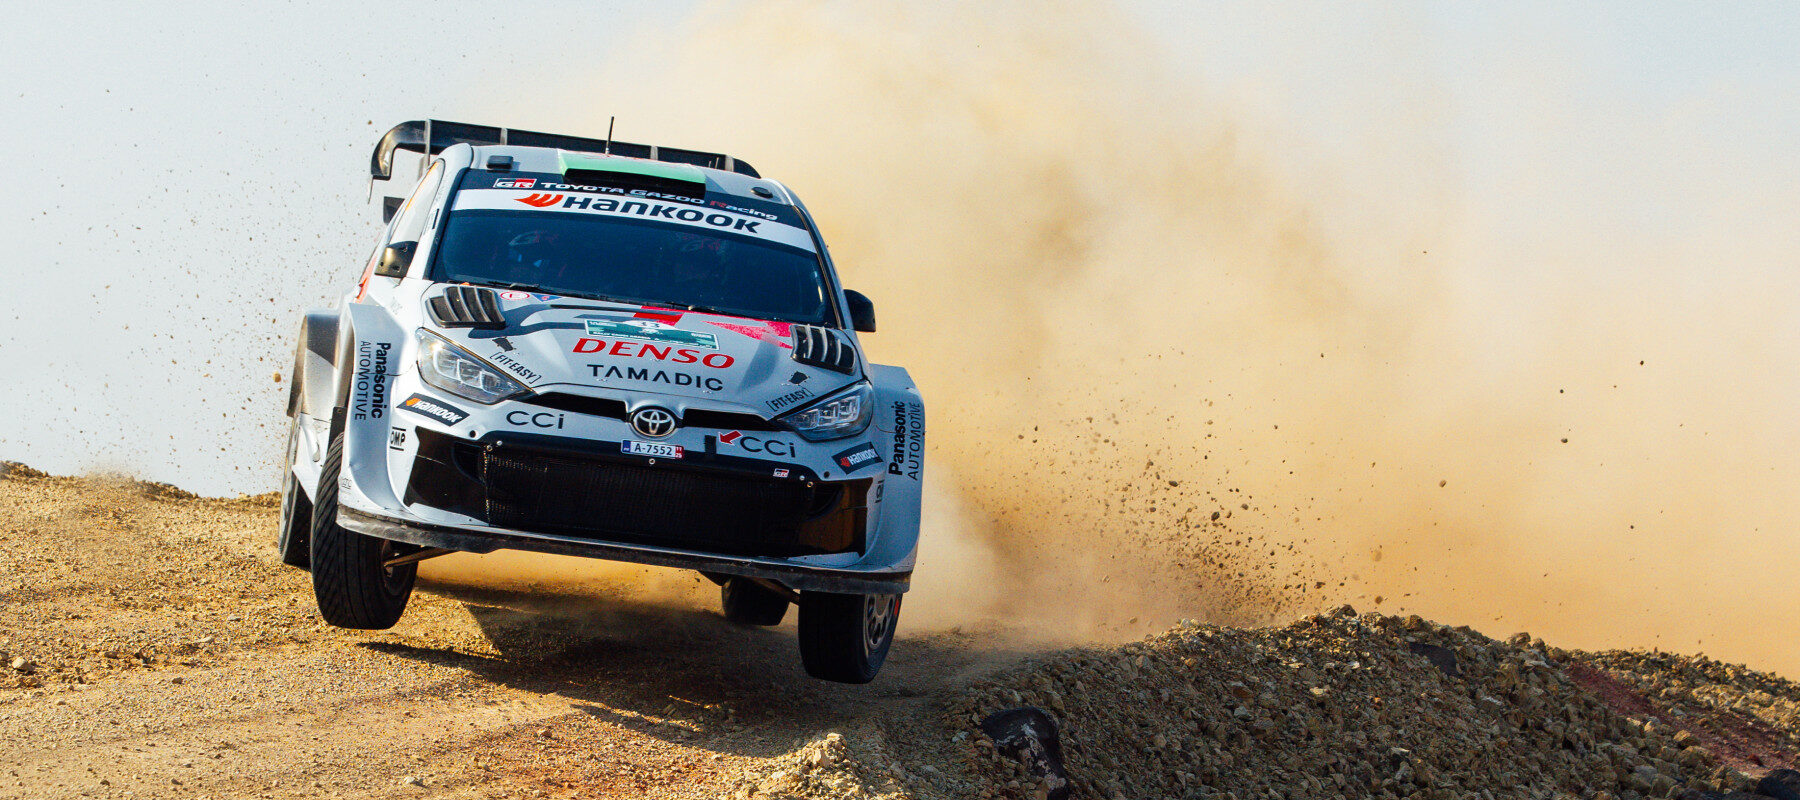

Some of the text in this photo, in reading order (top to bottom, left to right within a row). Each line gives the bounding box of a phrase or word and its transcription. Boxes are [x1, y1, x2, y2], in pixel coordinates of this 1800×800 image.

[541, 182, 624, 194] TOYOTA
[629, 189, 705, 204] GAZOO
[709, 200, 778, 221] Racing
[355, 341, 371, 420] AUTOMOTIVE
[371, 342, 391, 419] Panasonic
[573, 337, 735, 369] DENSO
[587, 364, 724, 391] TAMADIC
[634, 443, 673, 456] A-7552
[889, 401, 906, 475] Panasonic
[908, 402, 921, 480] AUTOMOTIVE
